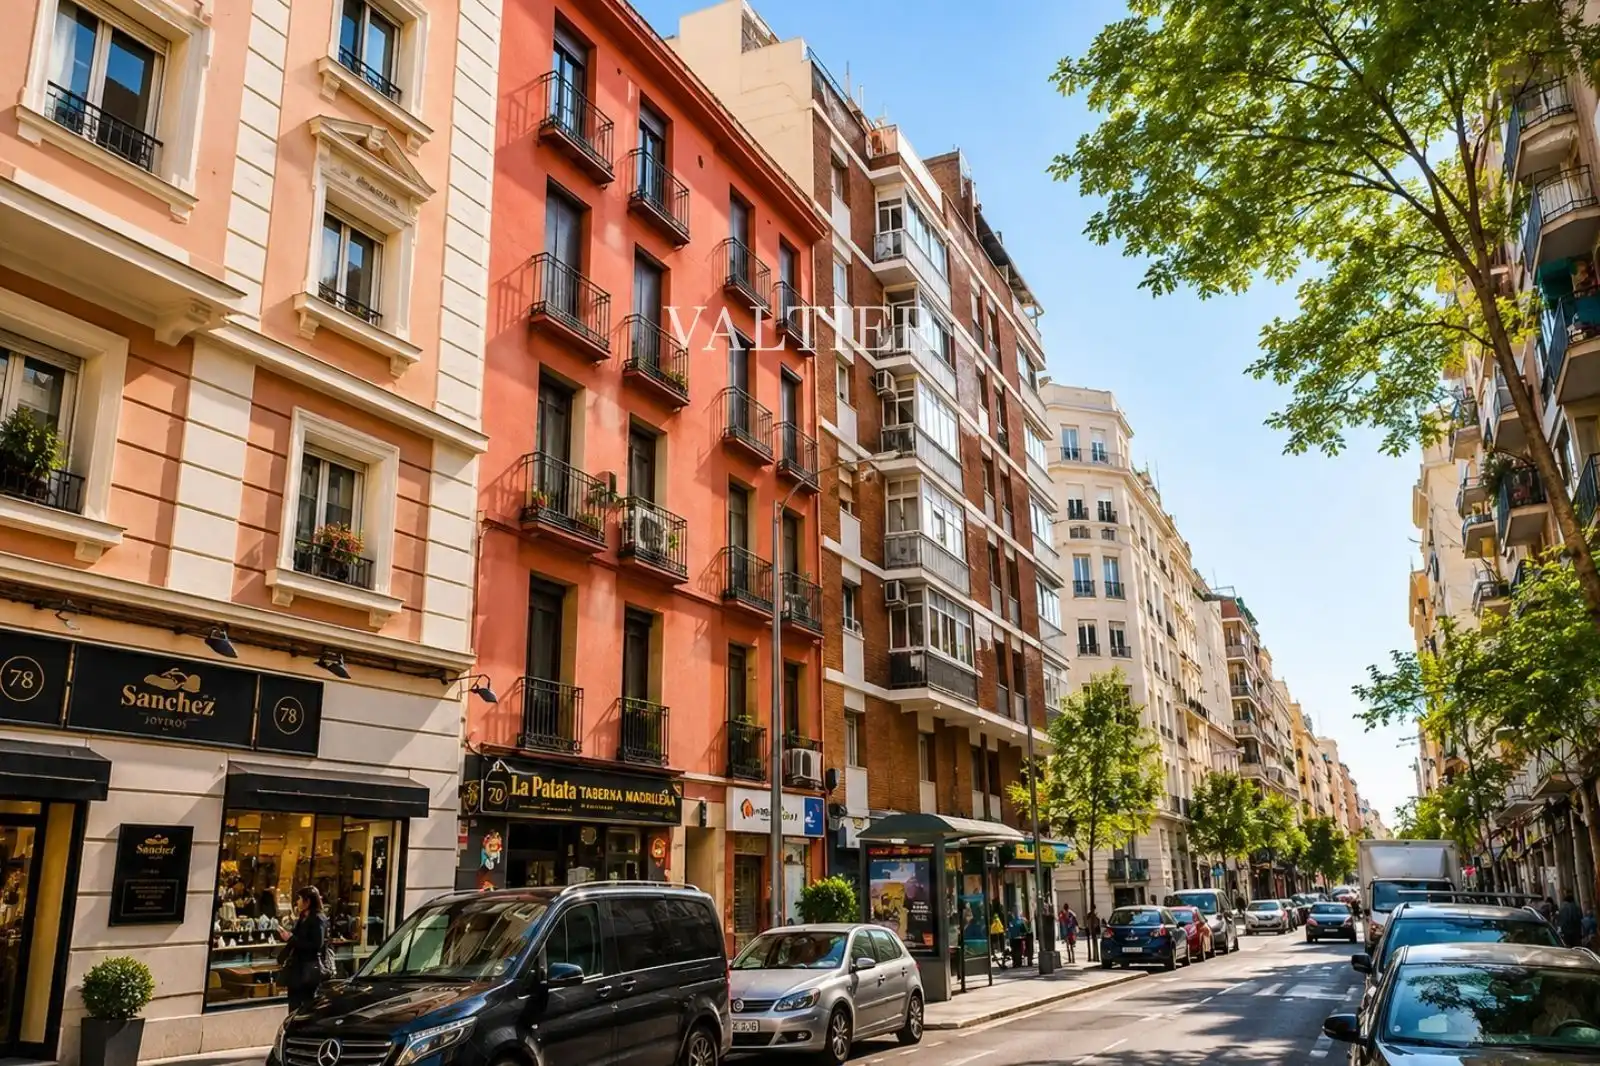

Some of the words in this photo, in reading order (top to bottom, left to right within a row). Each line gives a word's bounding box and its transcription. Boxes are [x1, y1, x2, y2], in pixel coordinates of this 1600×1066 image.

[10, 669, 34, 689] 78
[280, 707, 297, 724] 78
[510, 775, 529, 796] La
[532, 775, 577, 800] Patata
[579, 785, 623, 802] TABERNA
